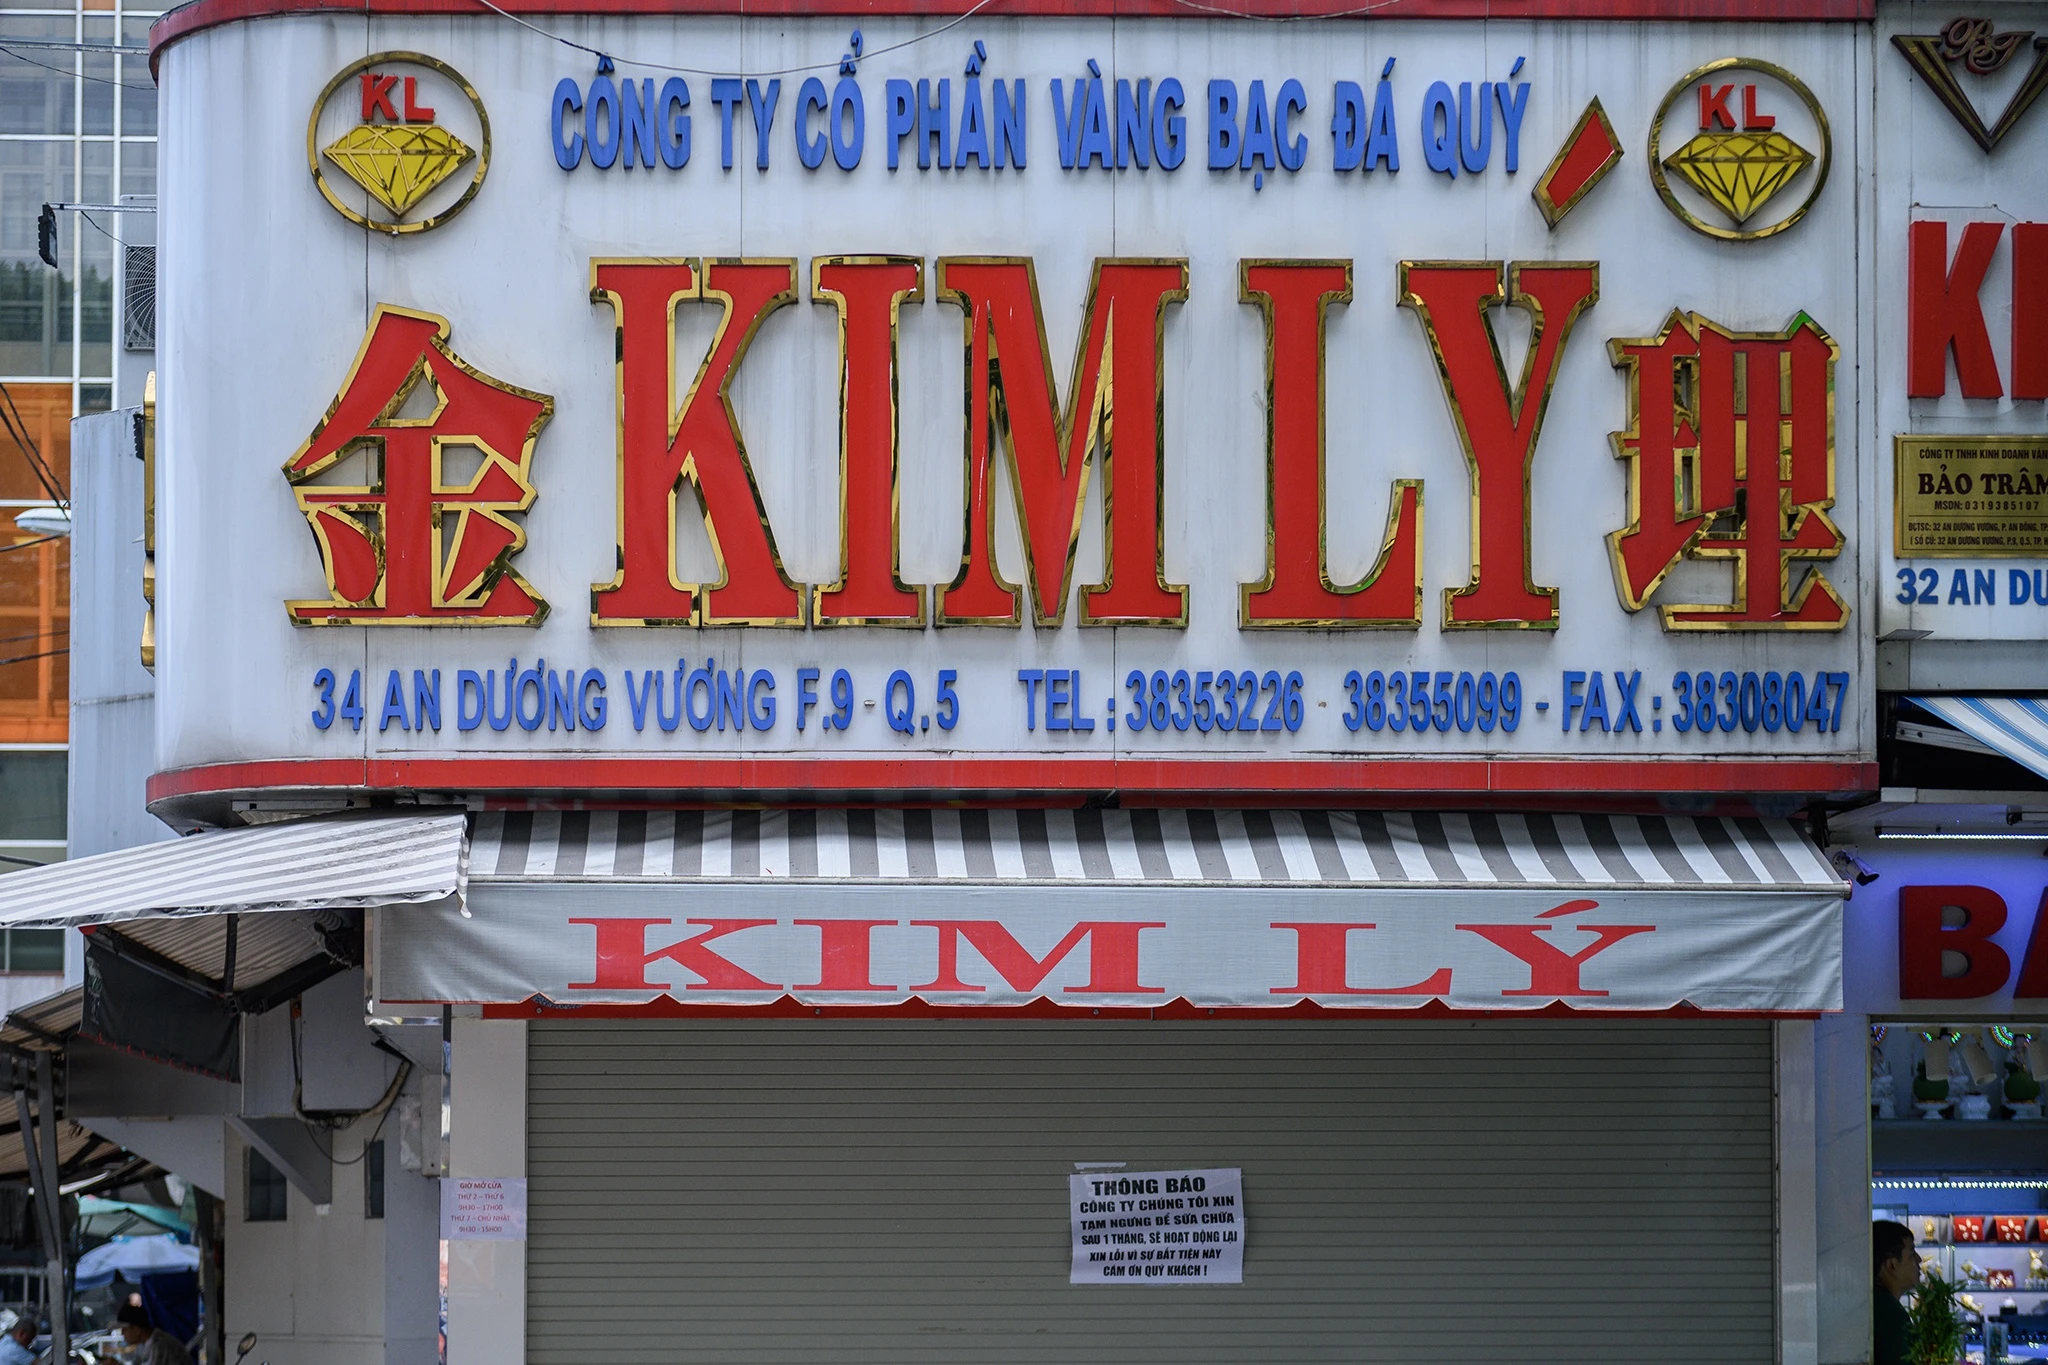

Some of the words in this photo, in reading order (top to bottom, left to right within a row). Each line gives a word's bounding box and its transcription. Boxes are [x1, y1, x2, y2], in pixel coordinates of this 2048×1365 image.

[359, 73, 435, 122] KL
[1697, 83, 1777, 132] KL
[551, 52, 691, 171] CÔNG
[711, 77, 781, 170] TY
[795, 29, 864, 171] CỔ
[886, 40, 1026, 171] PHẦN
[1049, 57, 1187, 171] VÀNG
[1207, 77, 1308, 191] BẠC
[1332, 56, 1400, 172] ĐÁ
[1421, 56, 1531, 180] QUÝ
[589, 256, 1189, 630] KIM
[1237, 95, 1625, 632] LÝ
[281, 301, 555, 628] 金
[1944, 449, 1954, 459] TY
[1956, 449, 1977, 459] TNHH
[1980, 449, 1999, 459] KINH
[2002, 449, 2029, 459] DOANH
[1605, 307, 1853, 633] 理
[1918, 464, 1972, 495] BẢO
[1934, 501, 1963, 510] MSDN:
[1933, 523, 1941, 531] 32
[1942, 523, 1952, 531] AN
[2009, 523, 2018, 531] AN
[1937, 537, 1945, 545] 32
[1947, 537, 1957, 545] AN
[1896, 568, 1939, 605] 32
[1948, 569, 1995, 606] AN
[311, 668, 364, 731] 34
[379, 668, 441, 731] AN
[457, 657, 607, 731] DƯƠNG
[623, 657, 776, 731] VƯƠNG
[1343, 670, 1523, 734] 38355099
[567, 915, 1166, 996] KIM
[1270, 898, 1657, 998] LÝ
[473, 1181, 486, 1189] MỞ
[487, 1181, 502, 1189] CỬA
[1091, 1177, 1159, 1196] THÔNG
[1165, 1175, 1206, 1193] BÁO
[1080, 1200, 1115, 1213] CÔNG
[1119, 1200, 1135, 1212] TY
[1139, 1197, 1184, 1211] CHÚNG
[1187, 1195, 1209, 1208] TÔI
[1212, 1195, 1234, 1207] XIN
[451, 1213, 466, 1221] THỨ
[1080, 1219, 1106, 1231] TẠM
[1110, 1216, 1151, 1228] NGƯNG
[1081, 1234, 1100, 1245] SAU
[1103, 1234, 1108, 1244] 1
[1111, 1232, 1146, 1244] THÁNG,
[1164, 1231, 1190, 1245] HOẠT
[1192, 1229, 1220, 1245] ĐỘNG
[1223, 1230, 1238, 1244] LẠI
[1089, 1252, 1106, 1261] XIN
[1127, 1249, 1137, 1260] VÌ
[1140, 1249, 1155, 1262] SỰ
[1178, 1248, 1200, 1261] TIỆN
[1128, 1264, 1142, 1276] ƠN
[1167, 1264, 1201, 1276] KHÁCH
